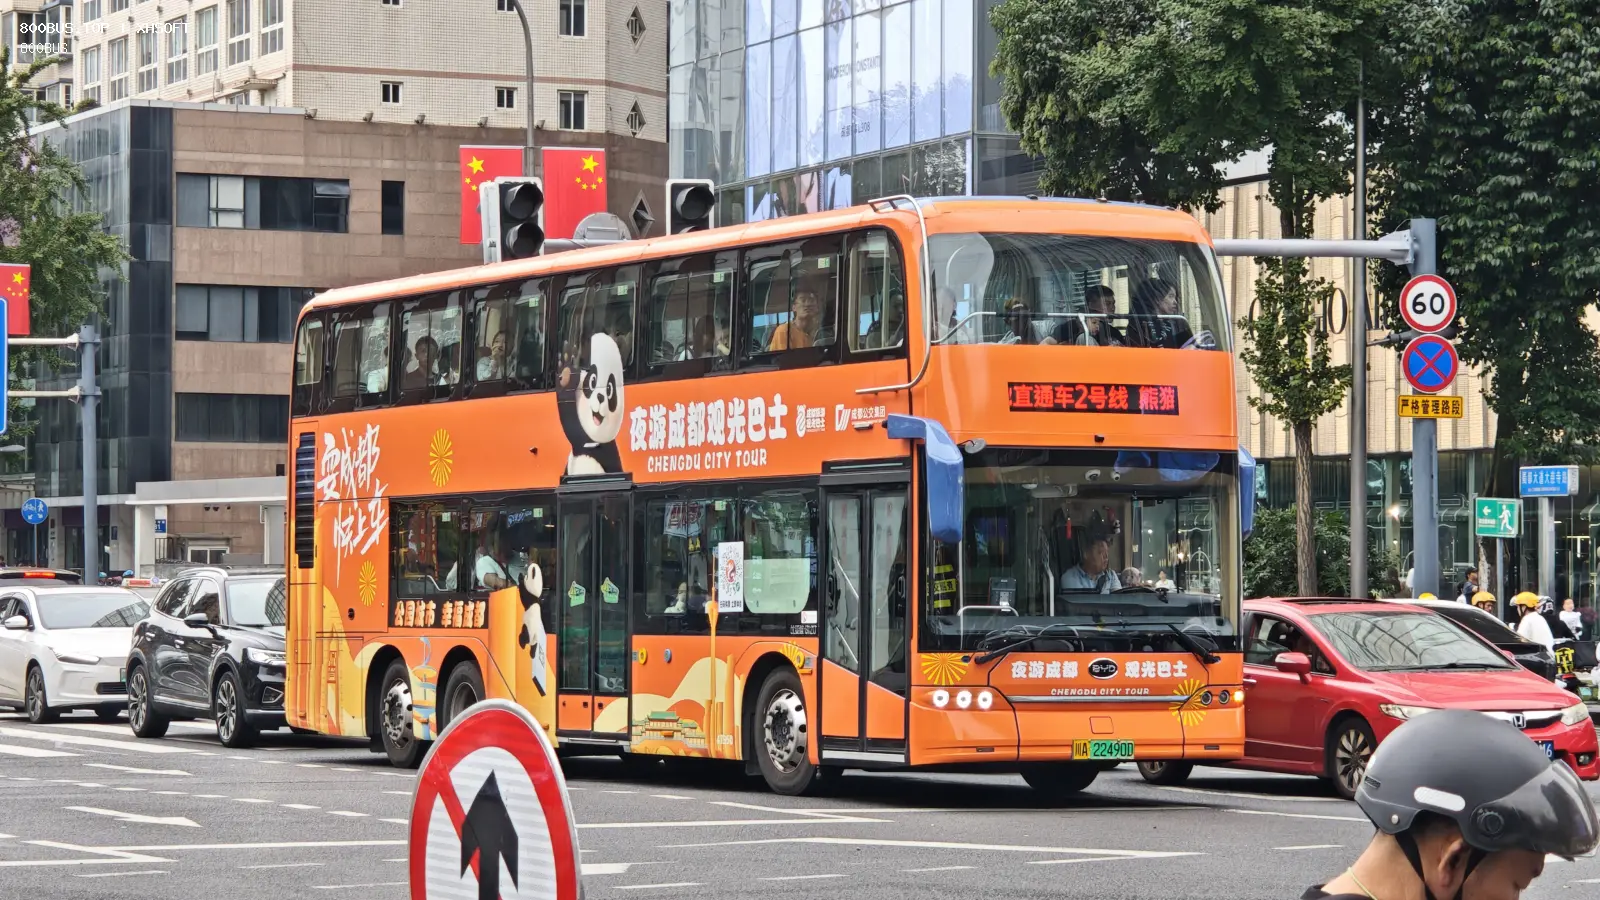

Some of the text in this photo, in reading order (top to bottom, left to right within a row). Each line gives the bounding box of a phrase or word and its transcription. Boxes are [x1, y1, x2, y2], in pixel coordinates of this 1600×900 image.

[1411, 292, 1445, 315] 60
[1008, 384, 1175, 411] 直通车2号线 熊猫
[1399, 398, 1462, 416] 严格管理路段
[851, 405, 886, 420] 成都公交集团
[629, 393, 789, 452] 夜游成都观光巴士
[647, 448, 767, 473] CHENGDU CITY TOUR
[394, 600, 486, 629] 公园城市 幸福成都
[1011, 660, 1079, 679] 夜游成都
[1092, 664, 1116, 673] BYD
[1124, 660, 1188, 679] 观光巴士
[1050, 687, 1150, 696] CHENGDU CITY TOUR
